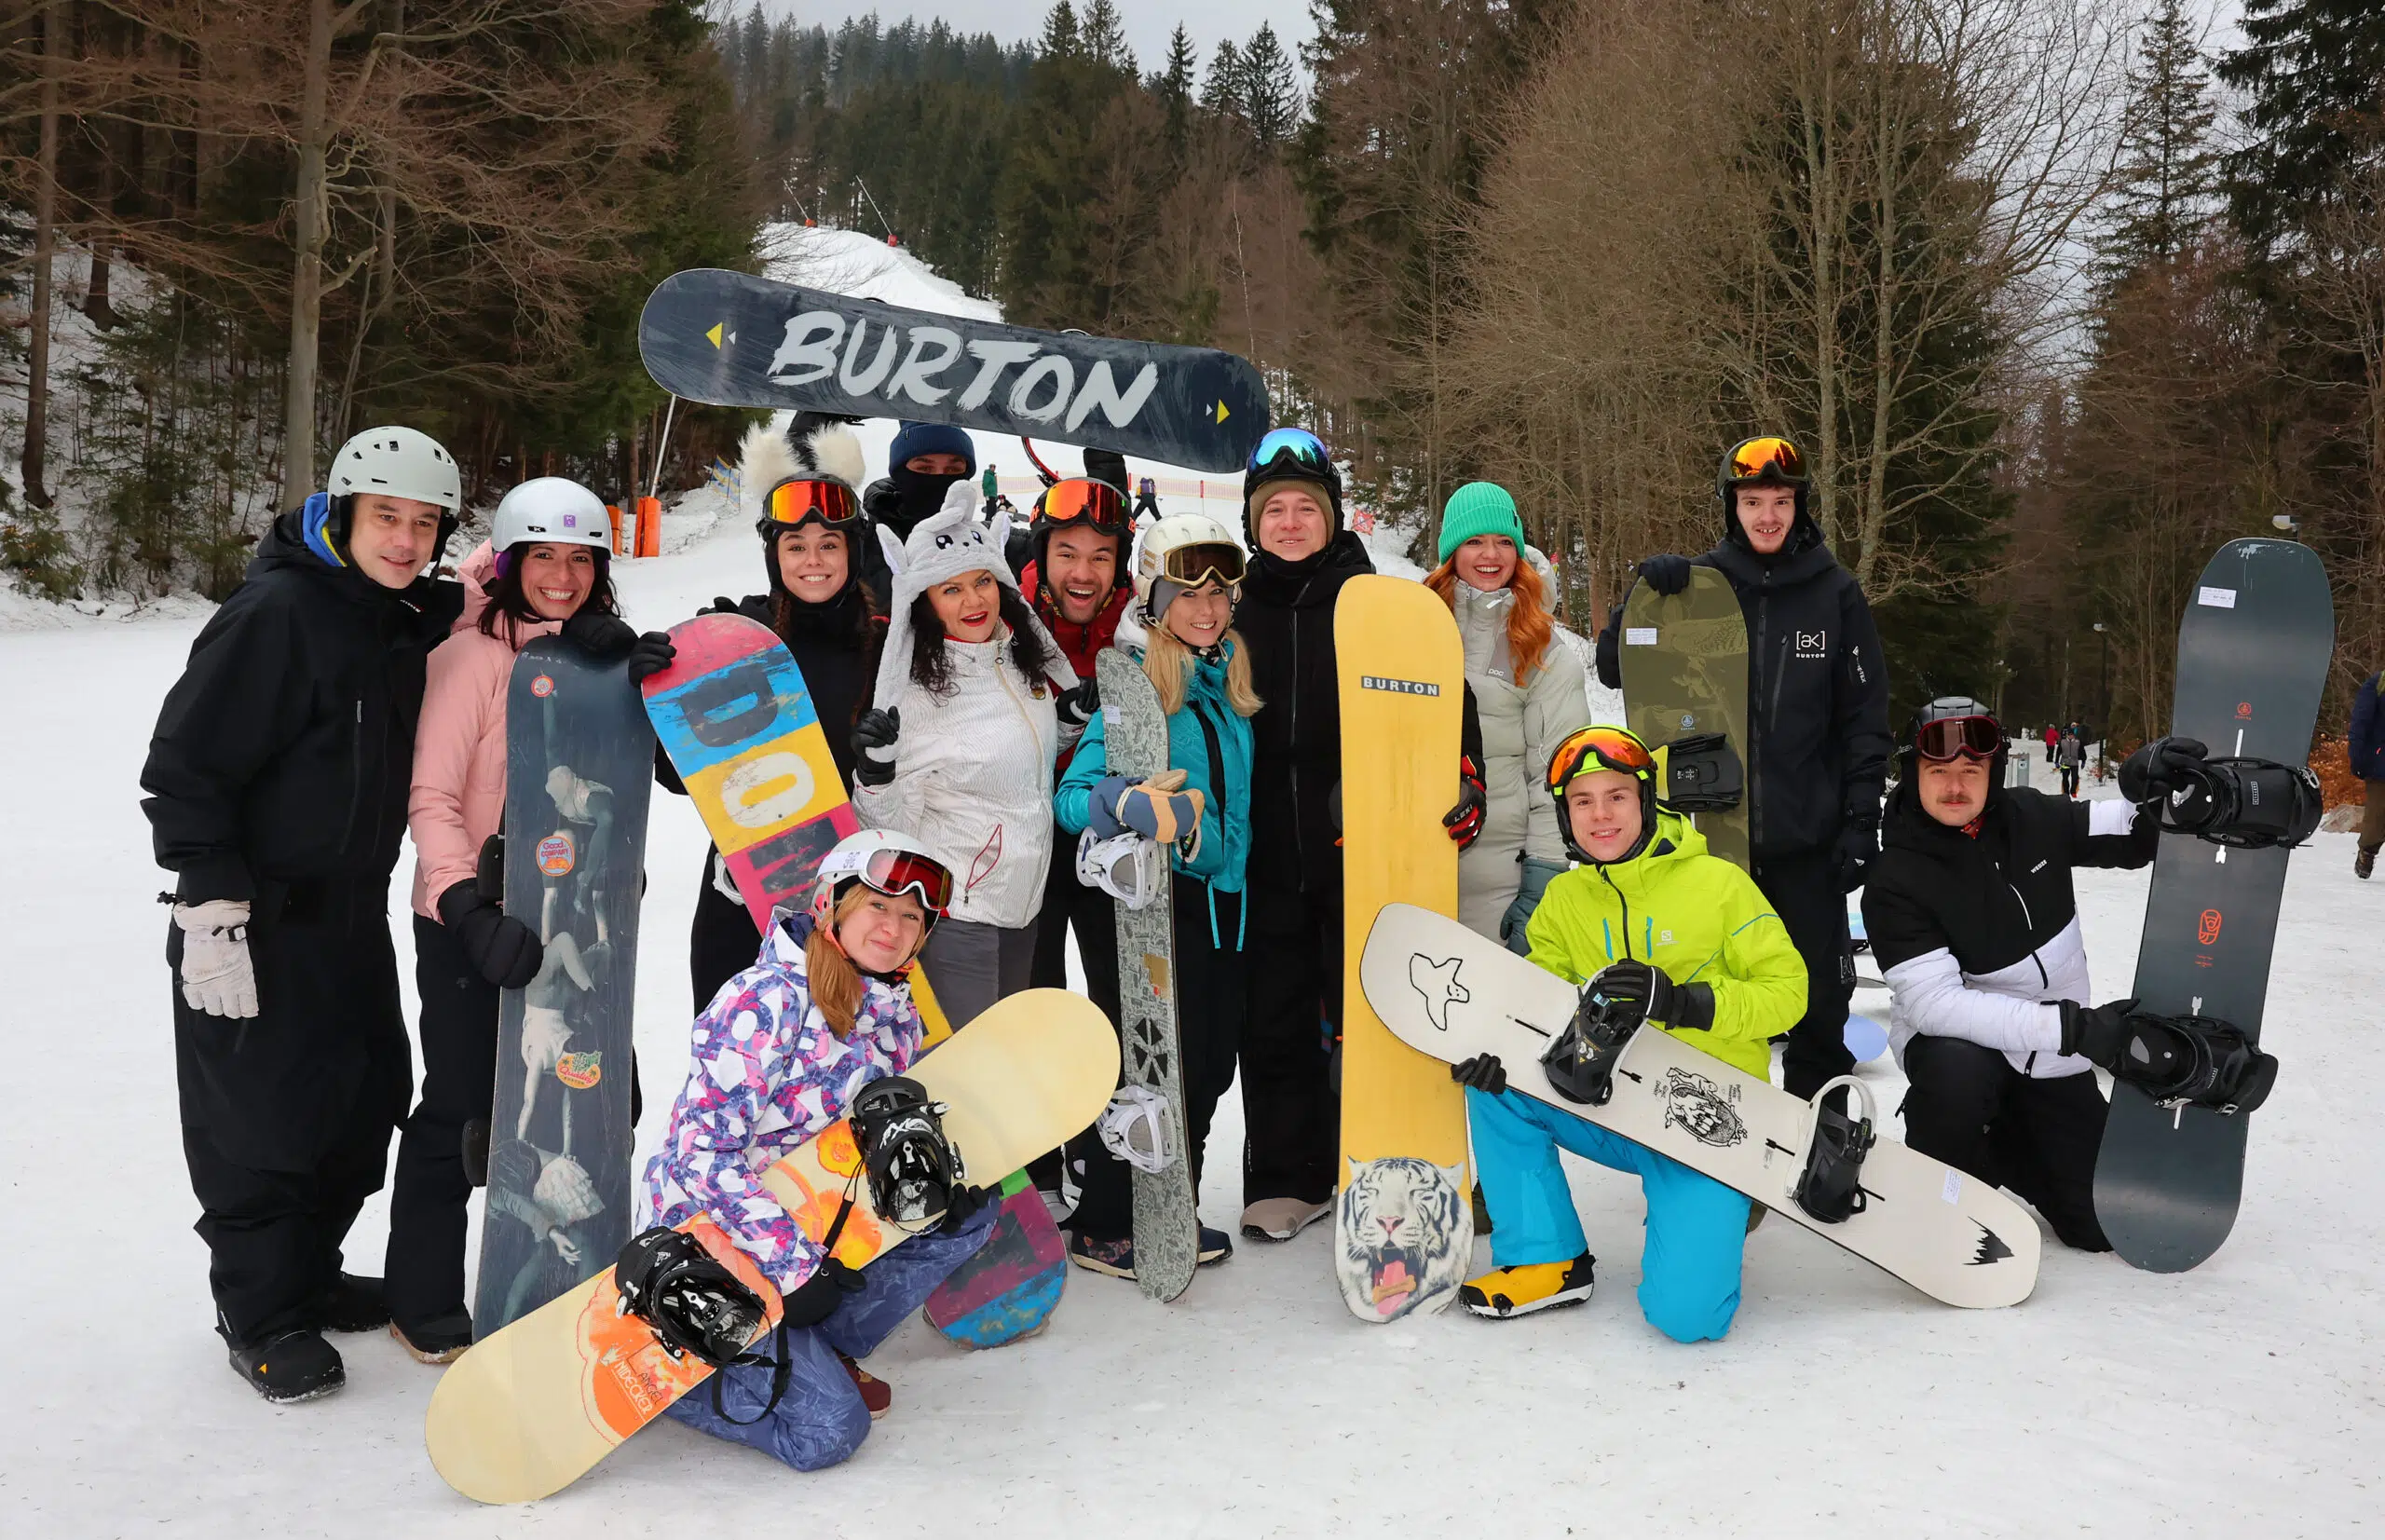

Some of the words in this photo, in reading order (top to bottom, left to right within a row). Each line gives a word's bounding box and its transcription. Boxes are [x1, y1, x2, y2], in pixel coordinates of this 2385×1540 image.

[767, 310, 1159, 433] BURTON
[1363, 676, 1438, 696] BURTON
[559, 1066, 594, 1084] Quality
[613, 1360, 654, 1415] NIDECKER
[637, 1372, 664, 1405] ANGEL
